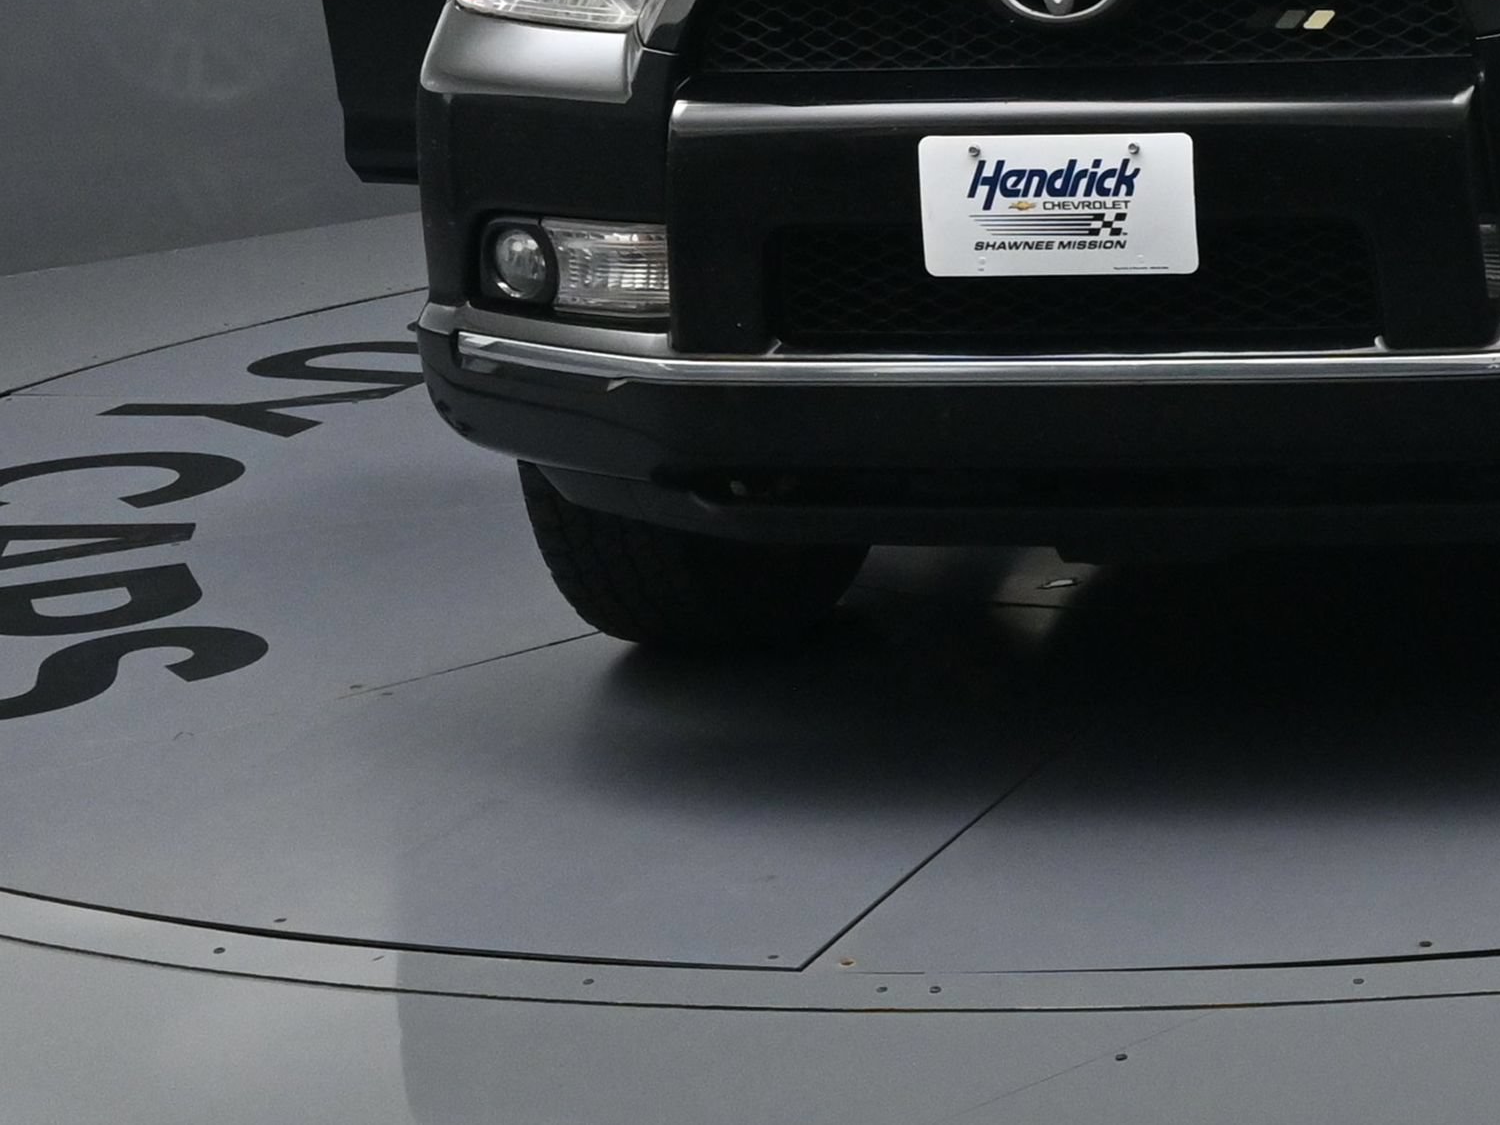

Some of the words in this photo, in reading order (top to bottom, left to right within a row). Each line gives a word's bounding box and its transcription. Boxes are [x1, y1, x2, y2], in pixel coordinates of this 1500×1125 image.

[967, 158, 1141, 211] Hendrick
[1042, 200, 1131, 211] CHEVROLET
[974, 240, 1055, 252] SHAWNEE
[1057, 239, 1127, 251] MISSION
